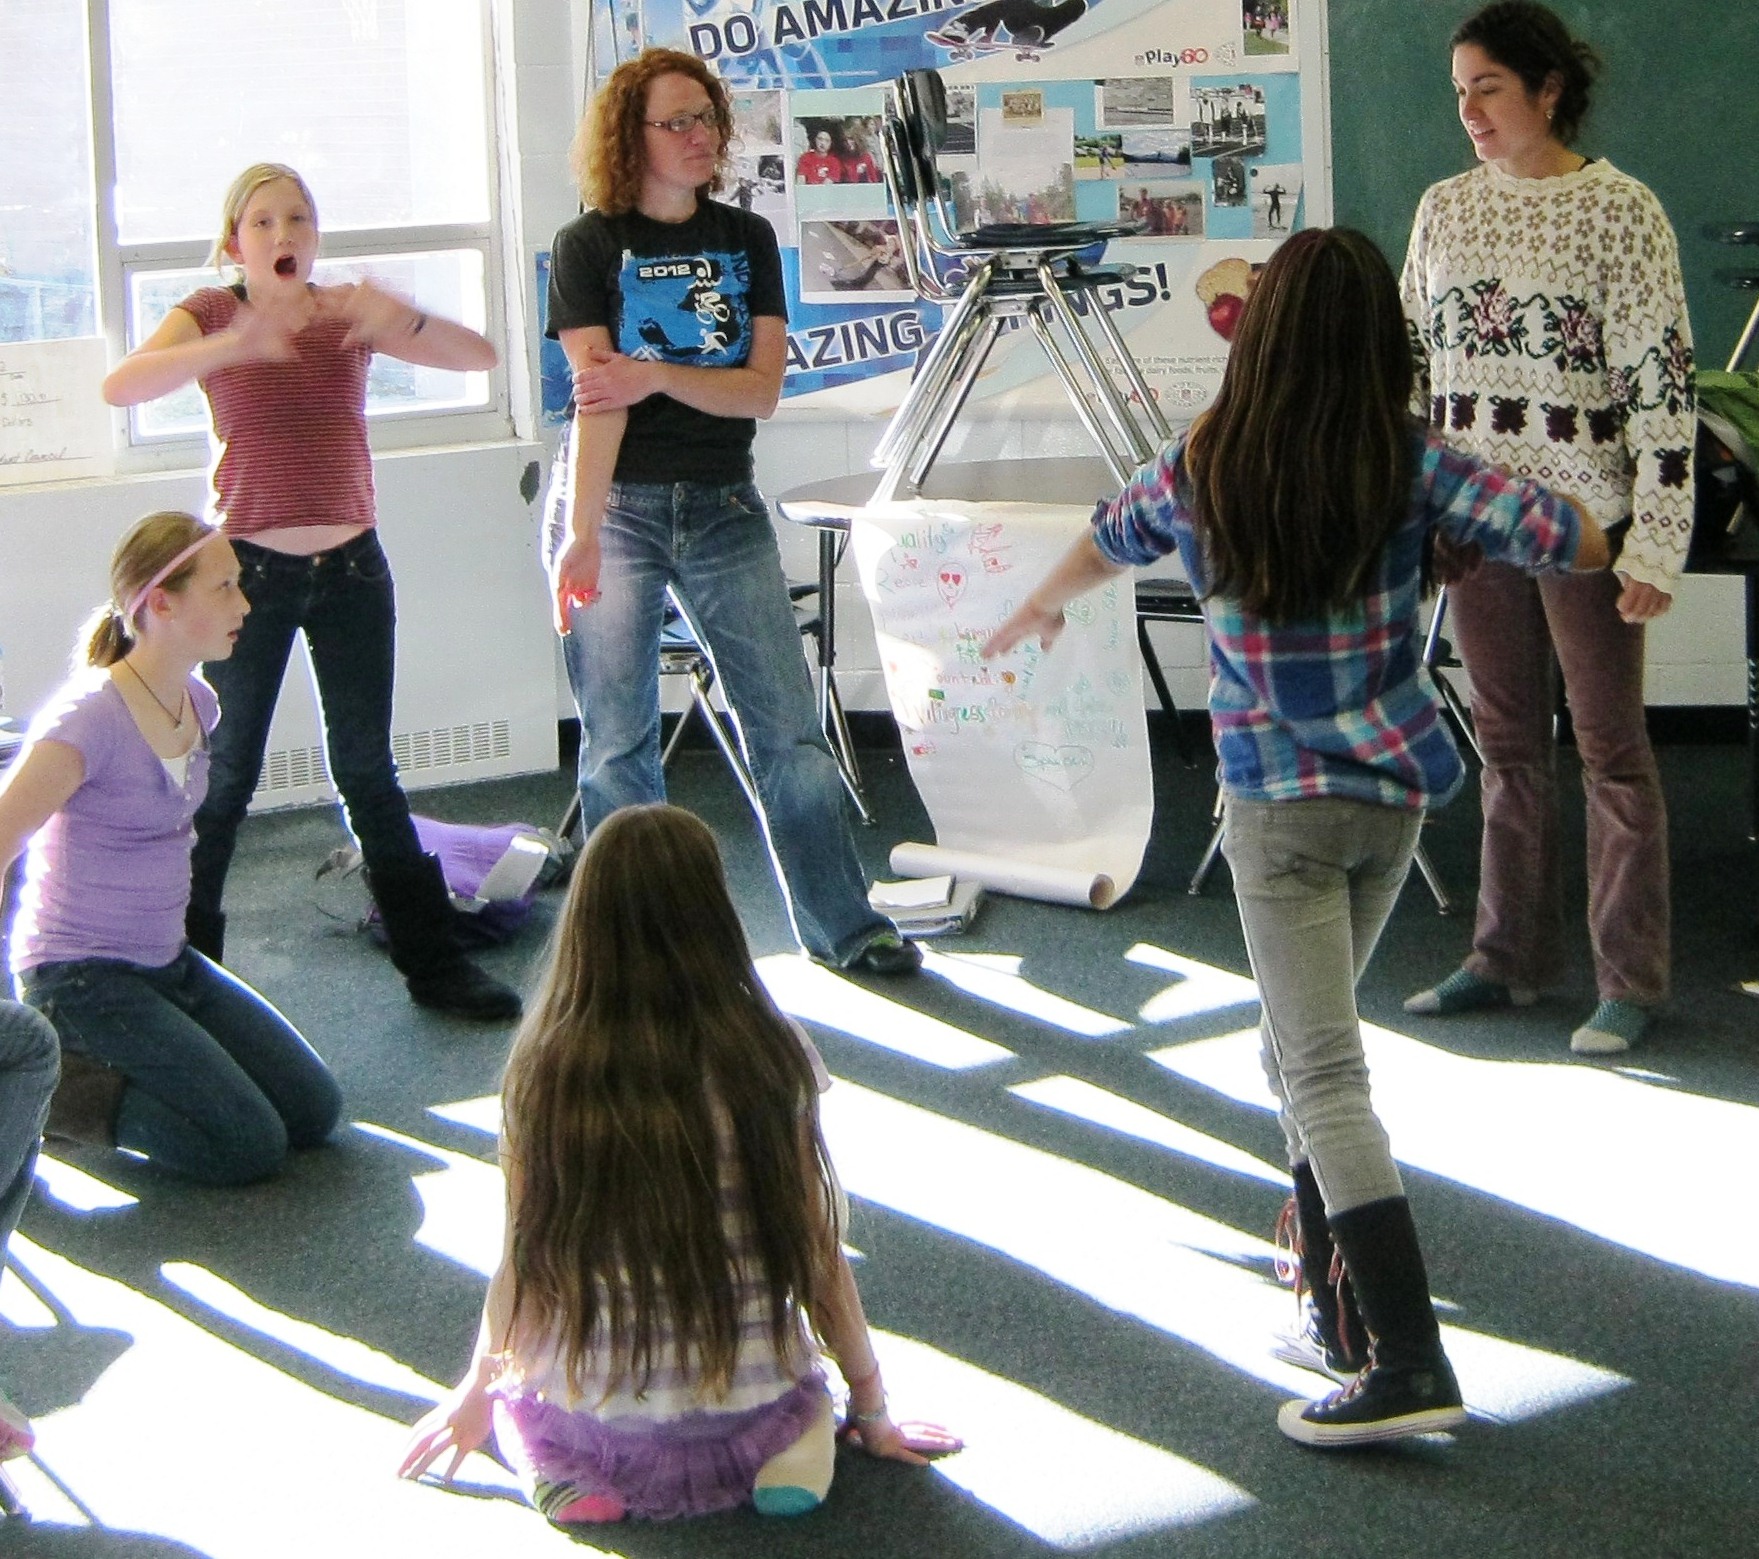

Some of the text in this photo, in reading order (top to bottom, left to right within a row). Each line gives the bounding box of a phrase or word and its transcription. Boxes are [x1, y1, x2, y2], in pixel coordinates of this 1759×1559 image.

[689, 0, 965, 58] DO AMAZ
[639, 264, 691, 278] 2012
